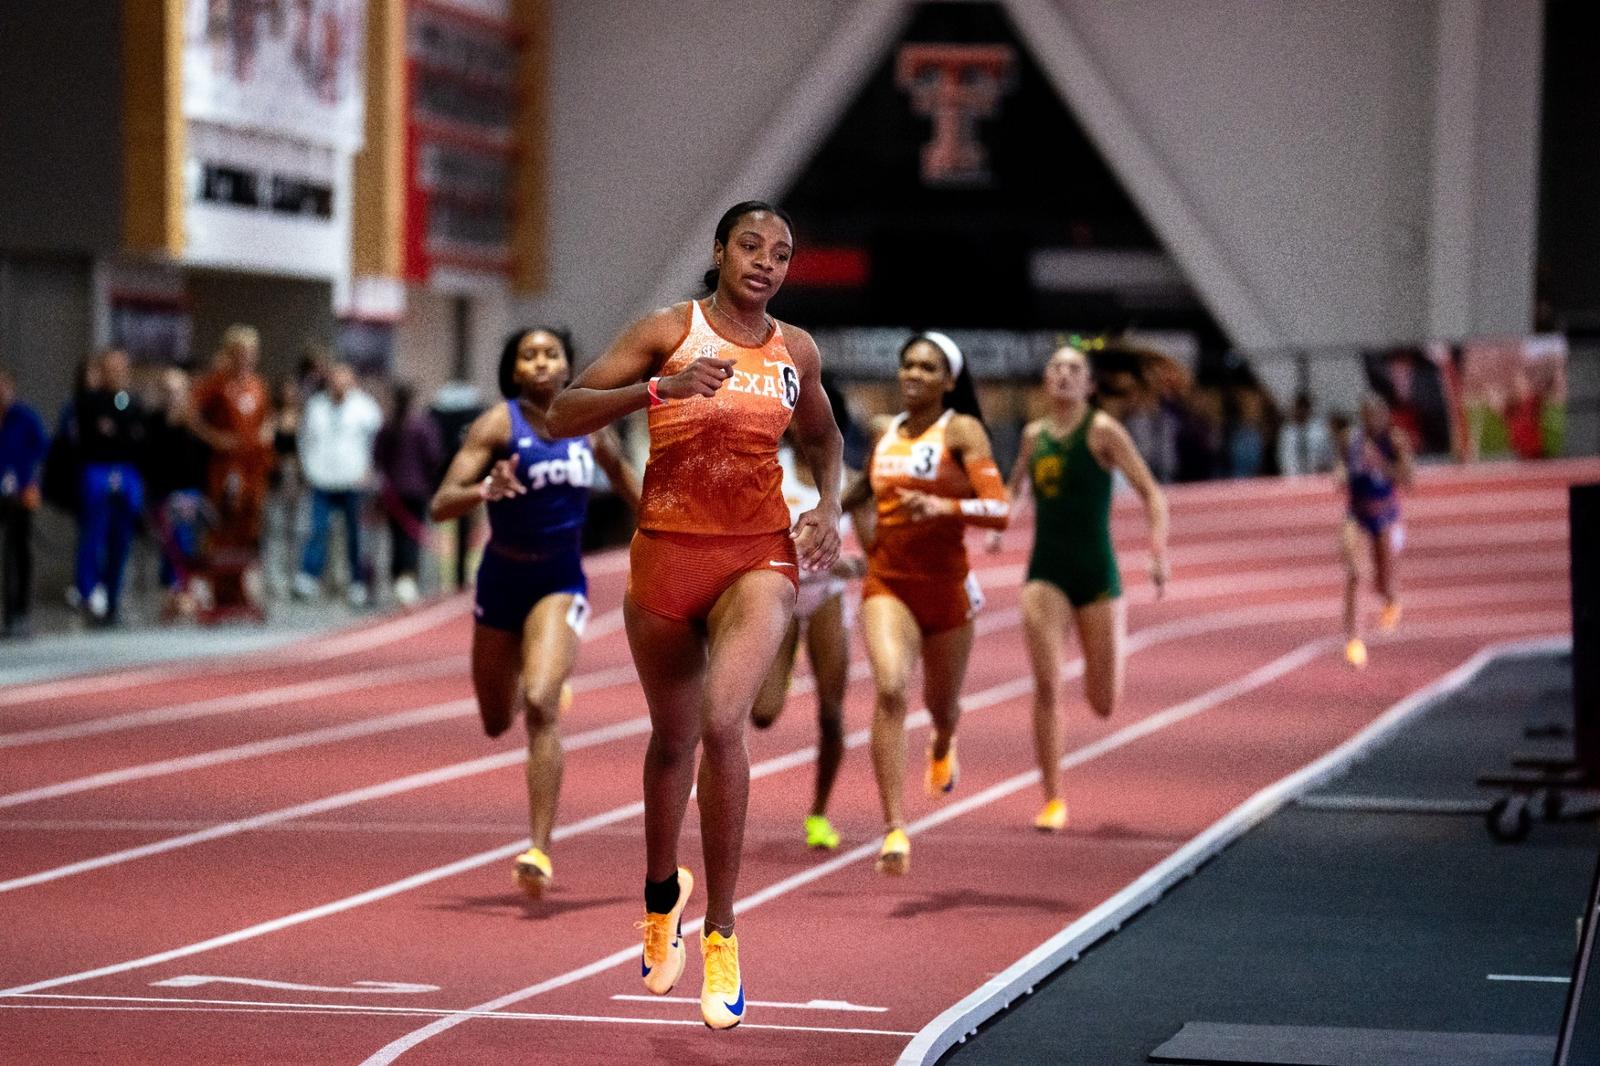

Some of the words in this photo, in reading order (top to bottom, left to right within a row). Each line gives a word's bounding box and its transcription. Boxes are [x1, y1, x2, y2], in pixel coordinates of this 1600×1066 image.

[727, 370, 783, 399] EXA
[783, 366, 799, 407] 6
[914, 446, 934, 475] 3
